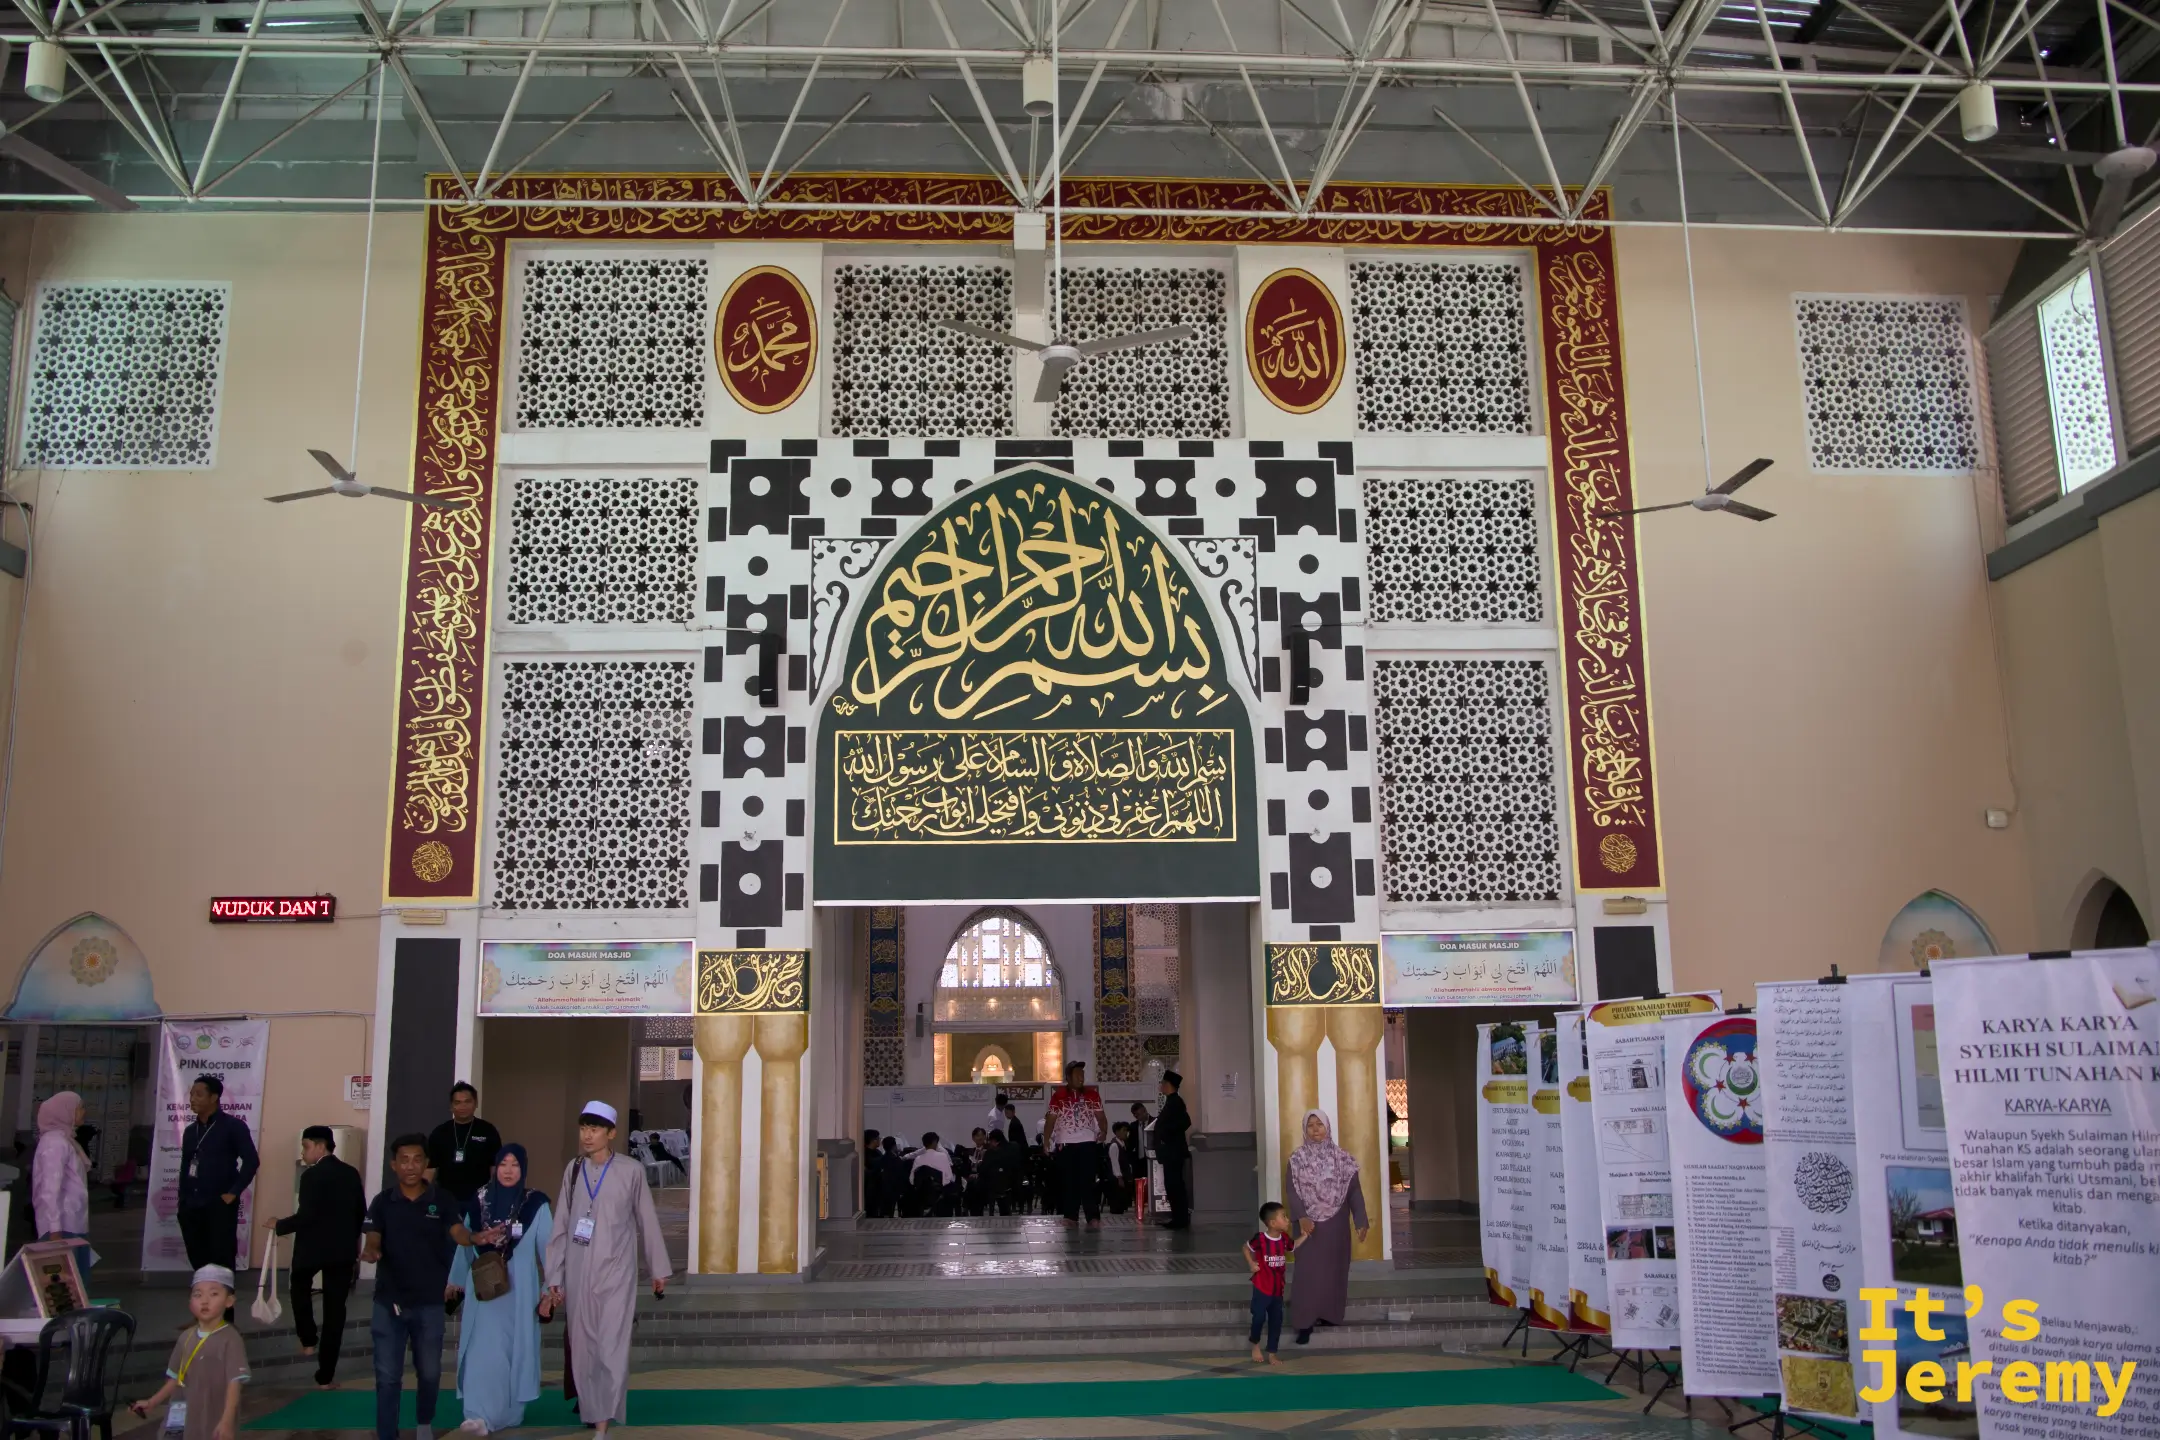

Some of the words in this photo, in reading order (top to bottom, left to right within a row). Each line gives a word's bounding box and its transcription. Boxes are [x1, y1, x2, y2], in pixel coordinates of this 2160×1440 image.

[279, 901, 317, 915] DAN
[1440, 942, 1457, 950] DOA
[1458, 942, 1488, 950] MASUK
[1489, 942, 1520, 950] MASJID
[548, 951, 566, 959] DOA
[568, 951, 599, 959] MASUK
[600, 951, 632, 959] MASJID
[1612, 1006, 1636, 1014] PROJEK
[1636, 1003, 1666, 1012] MAAHAD
[1666, 1001, 1691, 1009] TAHFIZ
[1612, 1010, 1666, 1020] SULAIMANIYYAH
[1667, 1008, 1690, 1016] TIMUR
[1982, 1018, 2054, 1034] KARYA
[2060, 1016, 2139, 1032] KARYA
[1960, 1043, 2040, 1060] SYEIKH
[180, 1060, 208, 1069] PINK
[208, 1061, 251, 1070] OCTOBER
[1954, 1068, 2020, 1084] HILMI
[2024, 1066, 2144, 1082] TUNAHAN
[2004, 1098, 2112, 1114] KARYA-KARYA
[1964, 1129, 2028, 1144] Walaupun
[2031, 1130, 2064, 1144] Syekh
[2068, 1130, 2128, 1142] Sulaiman
[1960, 1143, 2014, 1154] Tunahan
[2017, 1144, 2032, 1154] KS
[2034, 1144, 2074, 1156] adalah
[2078, 1146, 2130, 1158] seorang
[1954, 1158, 1988, 1168] besar
[1992, 1158, 2024, 1169] Islam
[2028, 1160, 2056, 1172] yang
[2058, 1159, 2111, 1170] tumbuh
[2114, 1160, 2145, 1172] pada
[1960, 1172, 1992, 1182] akhir
[1995, 1172, 2042, 1184] khalifah
[2045, 1172, 2074, 1184] Turki
[2078, 1174, 2136, 1188] Utsmani,
[1954, 1186, 1986, 1196] tidak
[1990, 1186, 2033, 1199] banyak
[2036, 1187, 2084, 1200] menulis
[2087, 1188, 2112, 1200] dan
[2052, 1202, 2086, 1214] kitab.
[2018, 1218, 2054, 1230] Ketika
[2056, 1220, 2132, 1236] ditanyakan,
[2025, 1238, 2056, 1249] Anda
[2058, 1239, 2089, 1251] tidak
[2093, 1241, 2145, 1254] menulis
[2041, 1316, 2072, 1328] Beliau
[2045, 1334, 2080, 1348] banyak
[2083, 1338, 2112, 1350] karya
[2116, 1340, 2152, 1354] ulama
[1988, 1342, 2020, 1353] ditulis
[2021, 1344, 2030, 1354] di
[2032, 1346, 2065, 1358] bawah
[2068, 1350, 2092, 1362] sinar
[2040, 1402, 2084, 1416] sampah.
[1984, 1406, 2012, 1418] karya
[2014, 1411, 2049, 1424] mereka
[2052, 1416, 2077, 1430] yang
[2079, 1418, 2118, 1433] terlihat
[1994, 1421, 2020, 1433] rusak
[2022, 1425, 2046, 1438] yang
